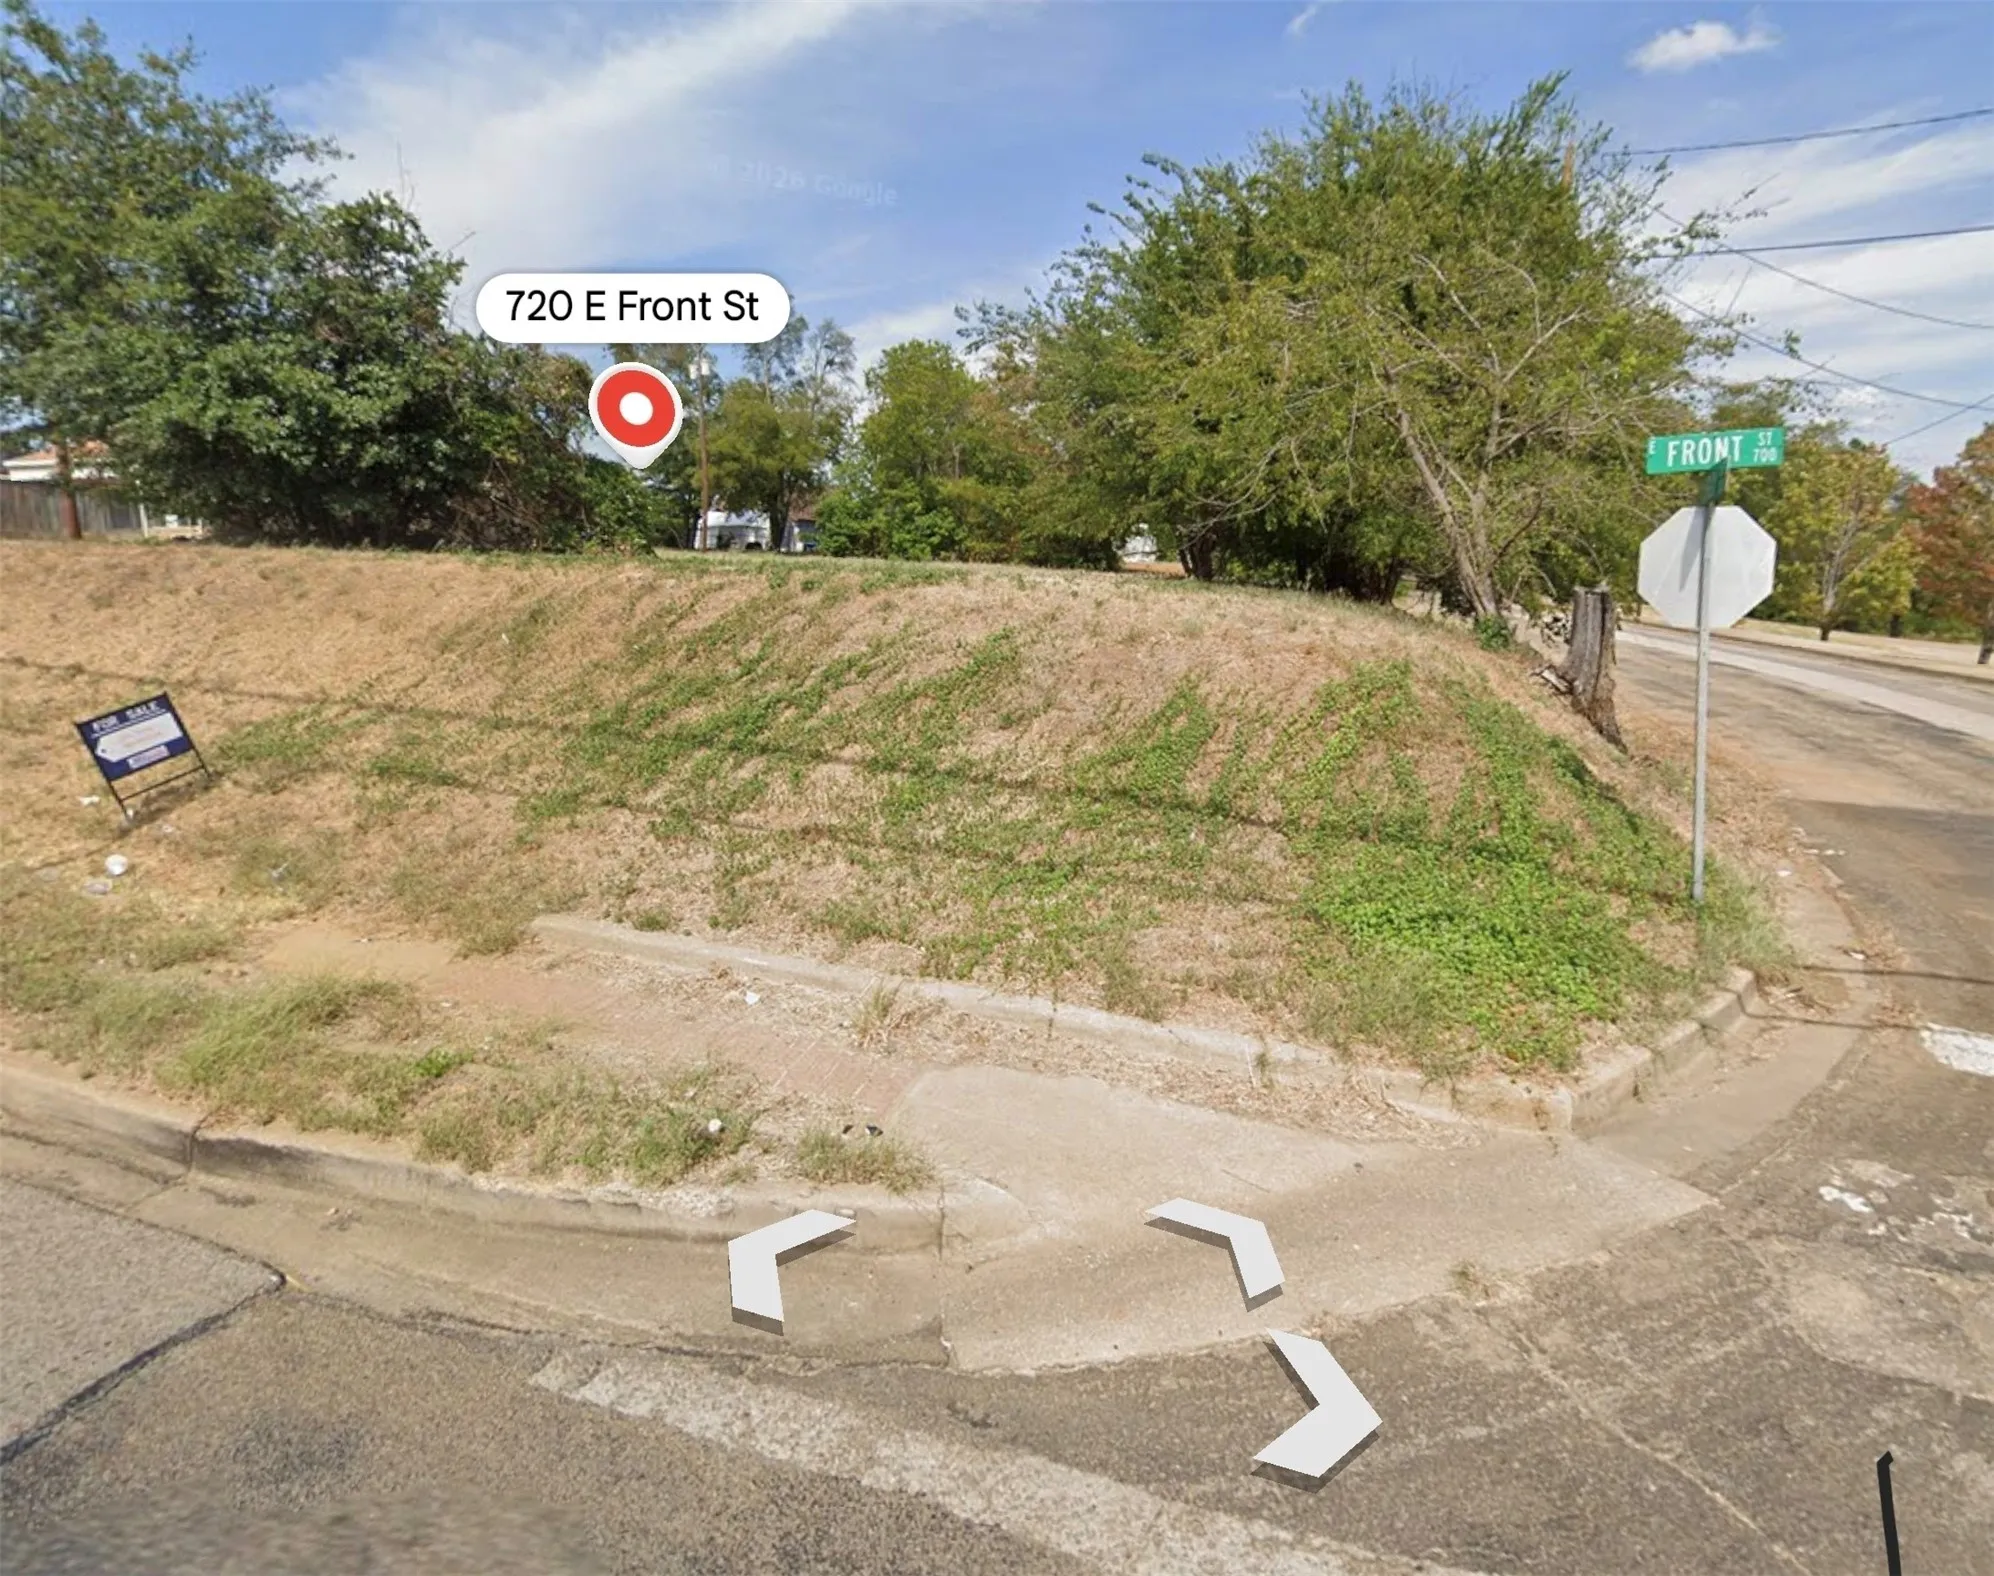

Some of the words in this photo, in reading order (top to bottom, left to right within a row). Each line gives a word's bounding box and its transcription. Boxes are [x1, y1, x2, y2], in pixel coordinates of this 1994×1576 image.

[1648, 440, 1656, 455] E
[1666, 435, 1744, 468] FRONT
[1758, 431, 1773, 446] ST
[1753, 447, 1778, 463] 700
